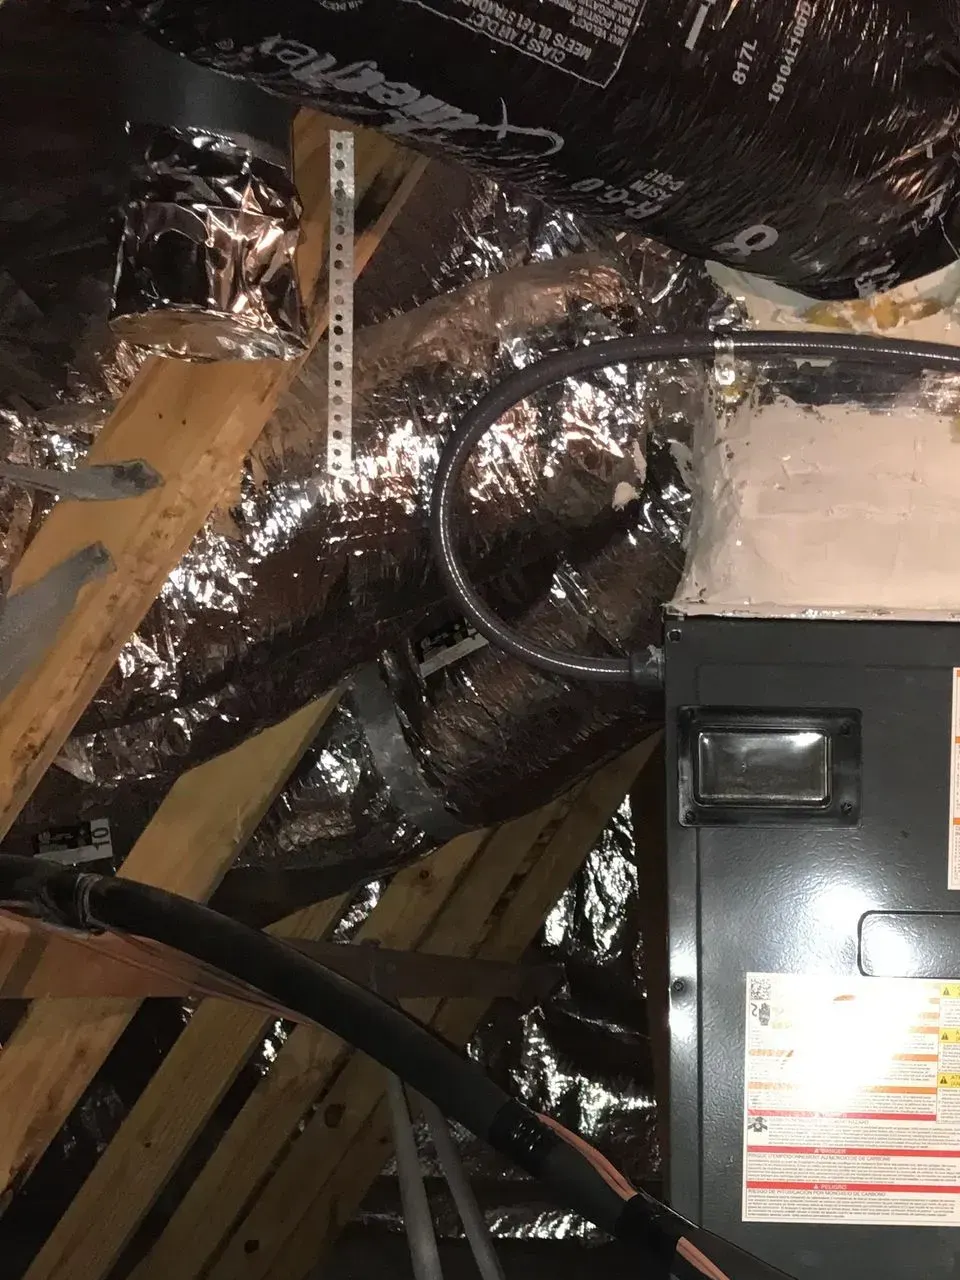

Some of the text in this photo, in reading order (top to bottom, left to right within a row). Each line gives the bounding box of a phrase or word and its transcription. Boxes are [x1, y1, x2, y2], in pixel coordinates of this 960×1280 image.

[465, 11, 500, 34] DUCT
[499, 24, 518, 42] AIR
[570, 15, 625, 47] MAX VELOCITY
[613, 24, 630, 38] MAX
[527, 38, 566, 63] CLASS
[552, 33, 592, 61] MEETS
[732, 39, 758, 85] 817L
[571, 177, 663, 220] R-6.0
[630, 179, 673, 202] ASTM
